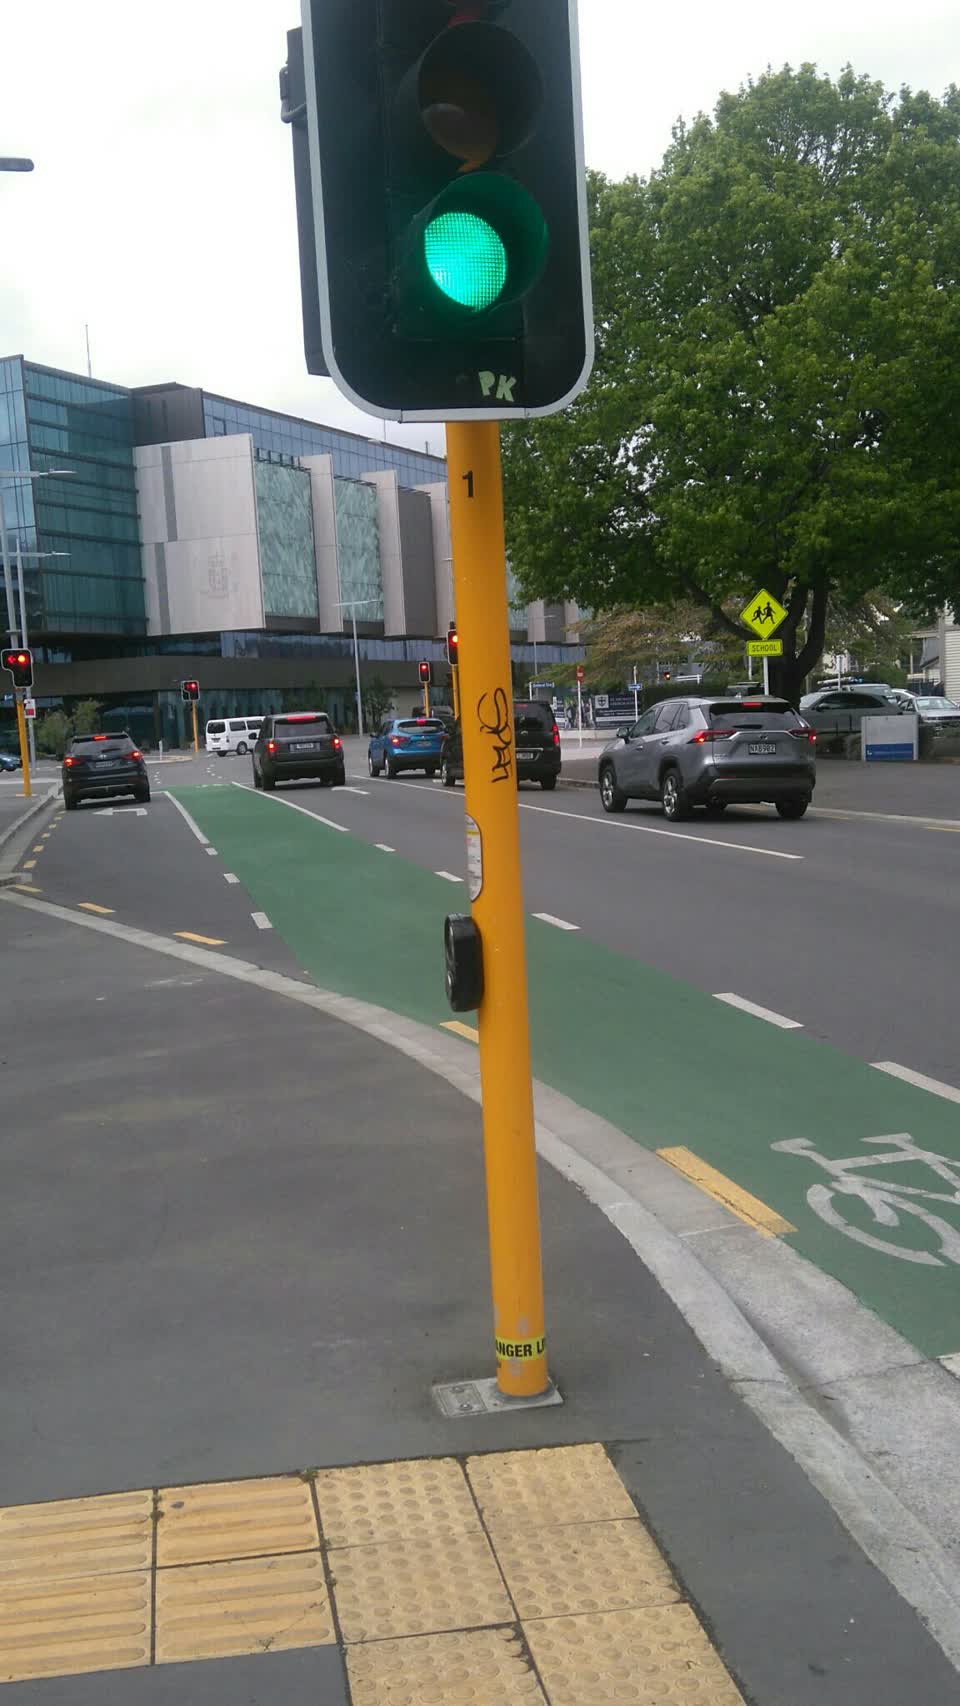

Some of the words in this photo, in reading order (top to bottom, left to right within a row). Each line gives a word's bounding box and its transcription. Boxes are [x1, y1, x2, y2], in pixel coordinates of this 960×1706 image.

[478, 370, 517, 402] PK
[462, 470, 473, 498] 1
[752, 644, 778, 652] SCHOOL
